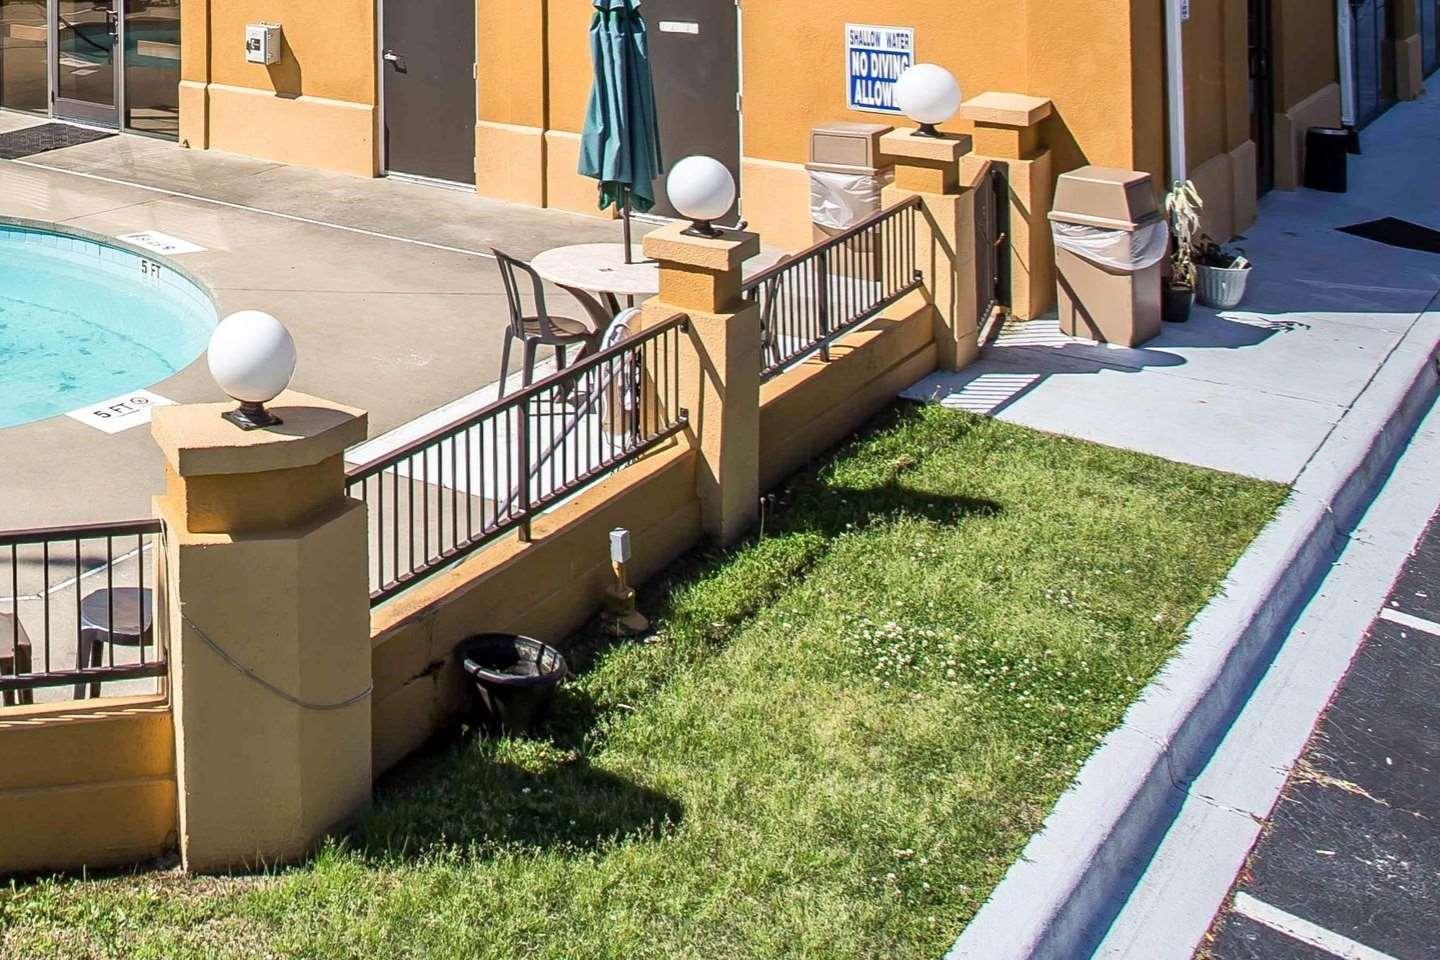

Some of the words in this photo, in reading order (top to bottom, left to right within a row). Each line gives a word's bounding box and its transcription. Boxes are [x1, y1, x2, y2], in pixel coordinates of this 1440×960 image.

[850, 30, 881, 46] SHALLOW
[886, 32, 909, 49] WATER
[852, 51, 868, 76] NO
[870, 52, 909, 79] DIVING
[854, 78, 899, 106] ALLOW
[141, 260, 148, 273] 5
[151, 263, 160, 278] FT
[93, 409, 111, 419] 5
[109, 402, 133, 414] FT
